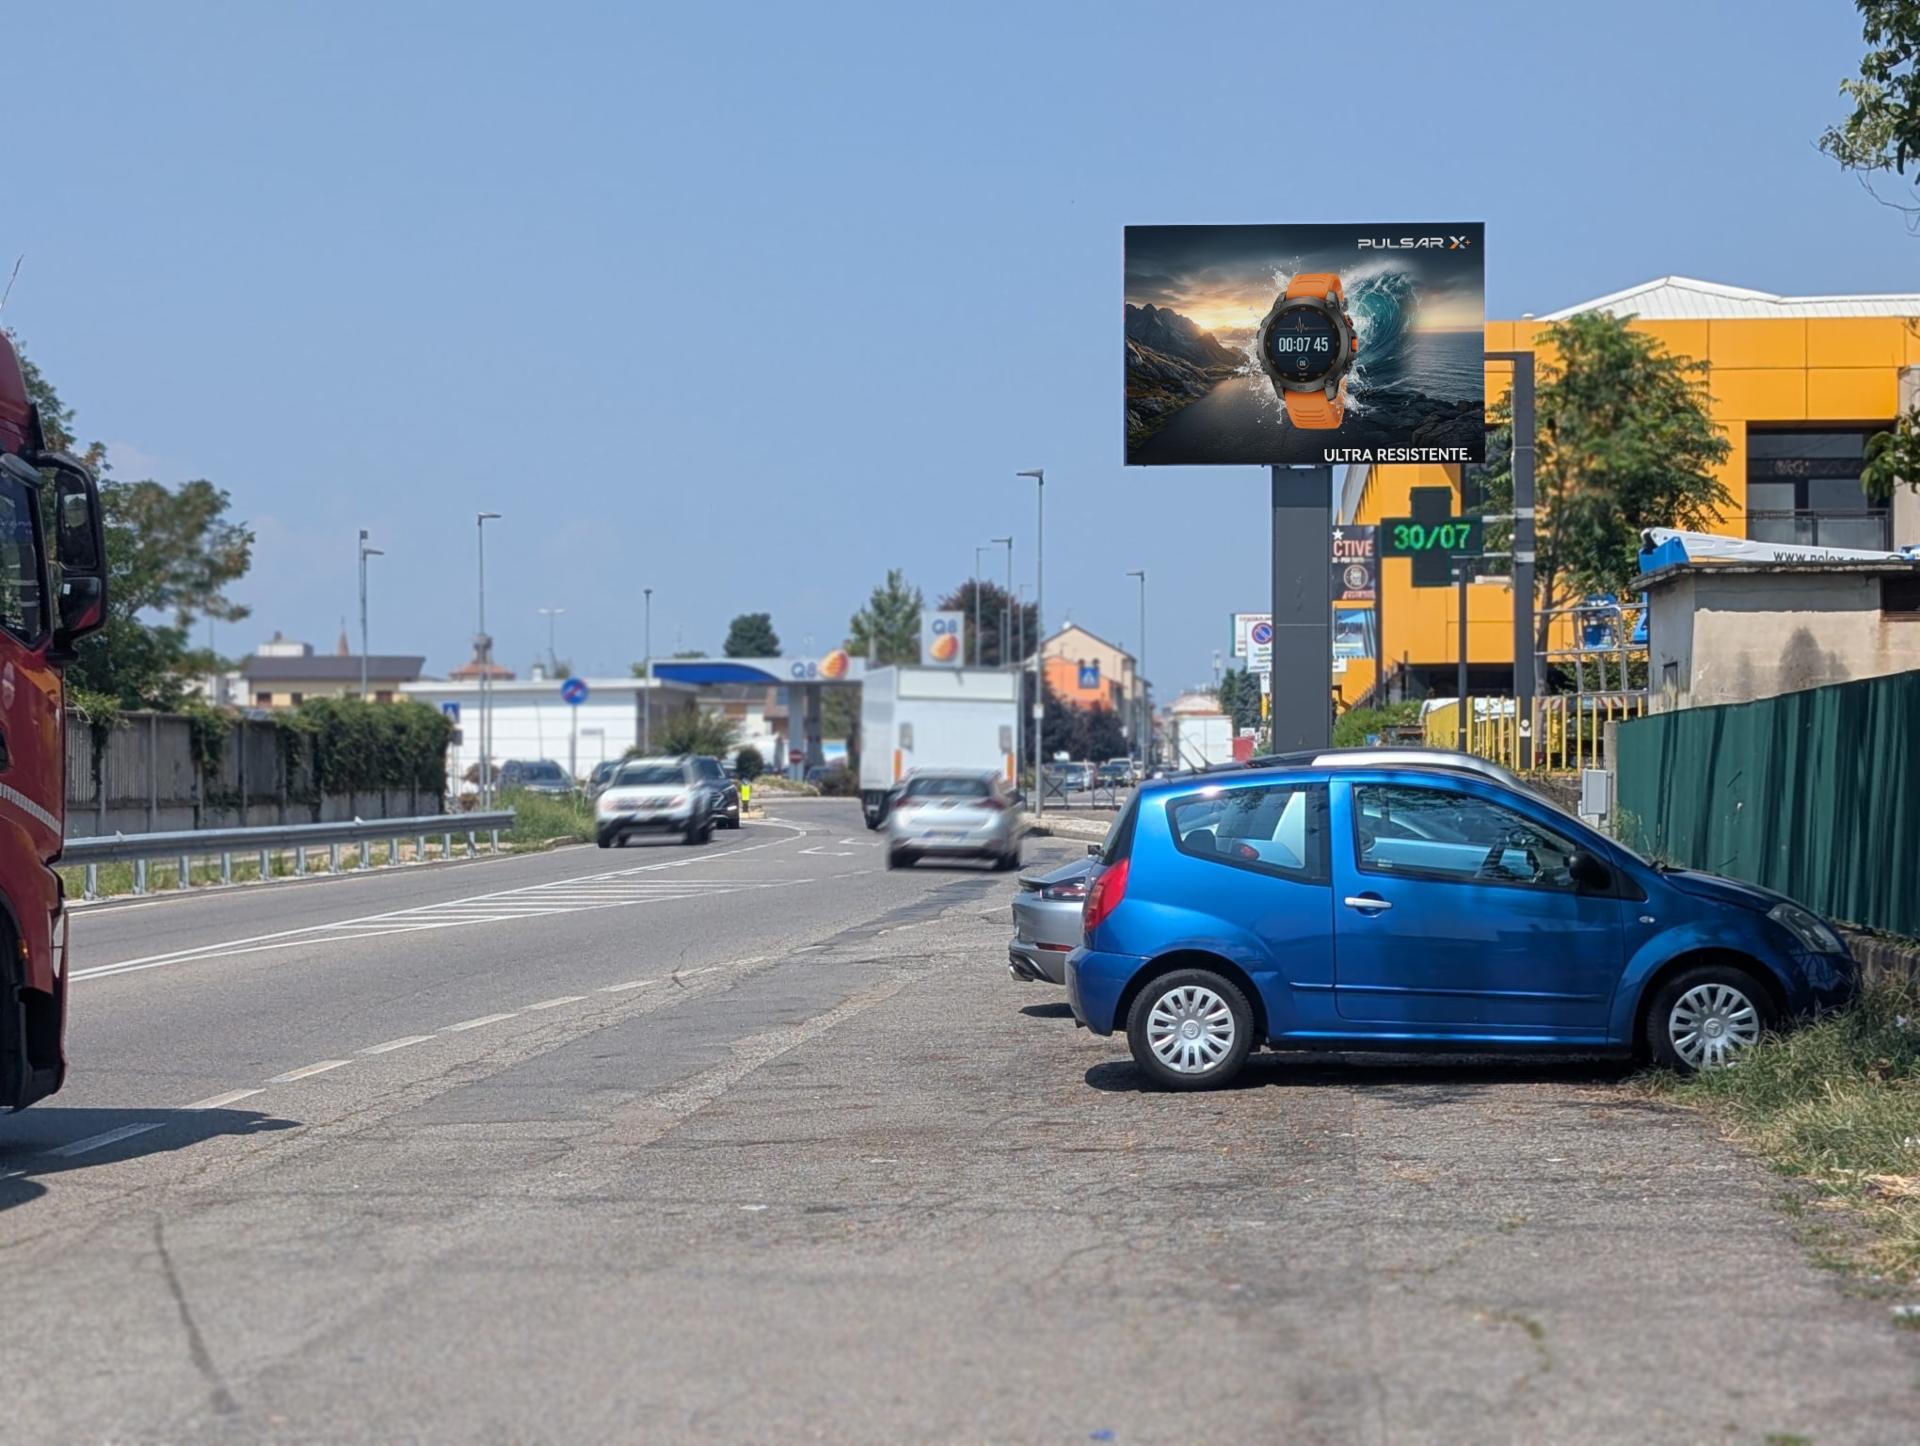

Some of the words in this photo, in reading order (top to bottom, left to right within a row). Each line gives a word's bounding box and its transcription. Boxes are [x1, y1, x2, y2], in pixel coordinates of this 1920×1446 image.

[1357, 237, 1445, 250] PULSAR
[1278, 336, 1311, 352] 00:07
[1313, 336, 1329, 352] 45
[1323, 448, 1373, 462] ULTRA
[1376, 447, 1473, 462] RESISTENTE.
[1393, 523, 1471, 550] 30/07
[931, 618, 958, 635] Q8
[790, 661, 817, 679] Q8
